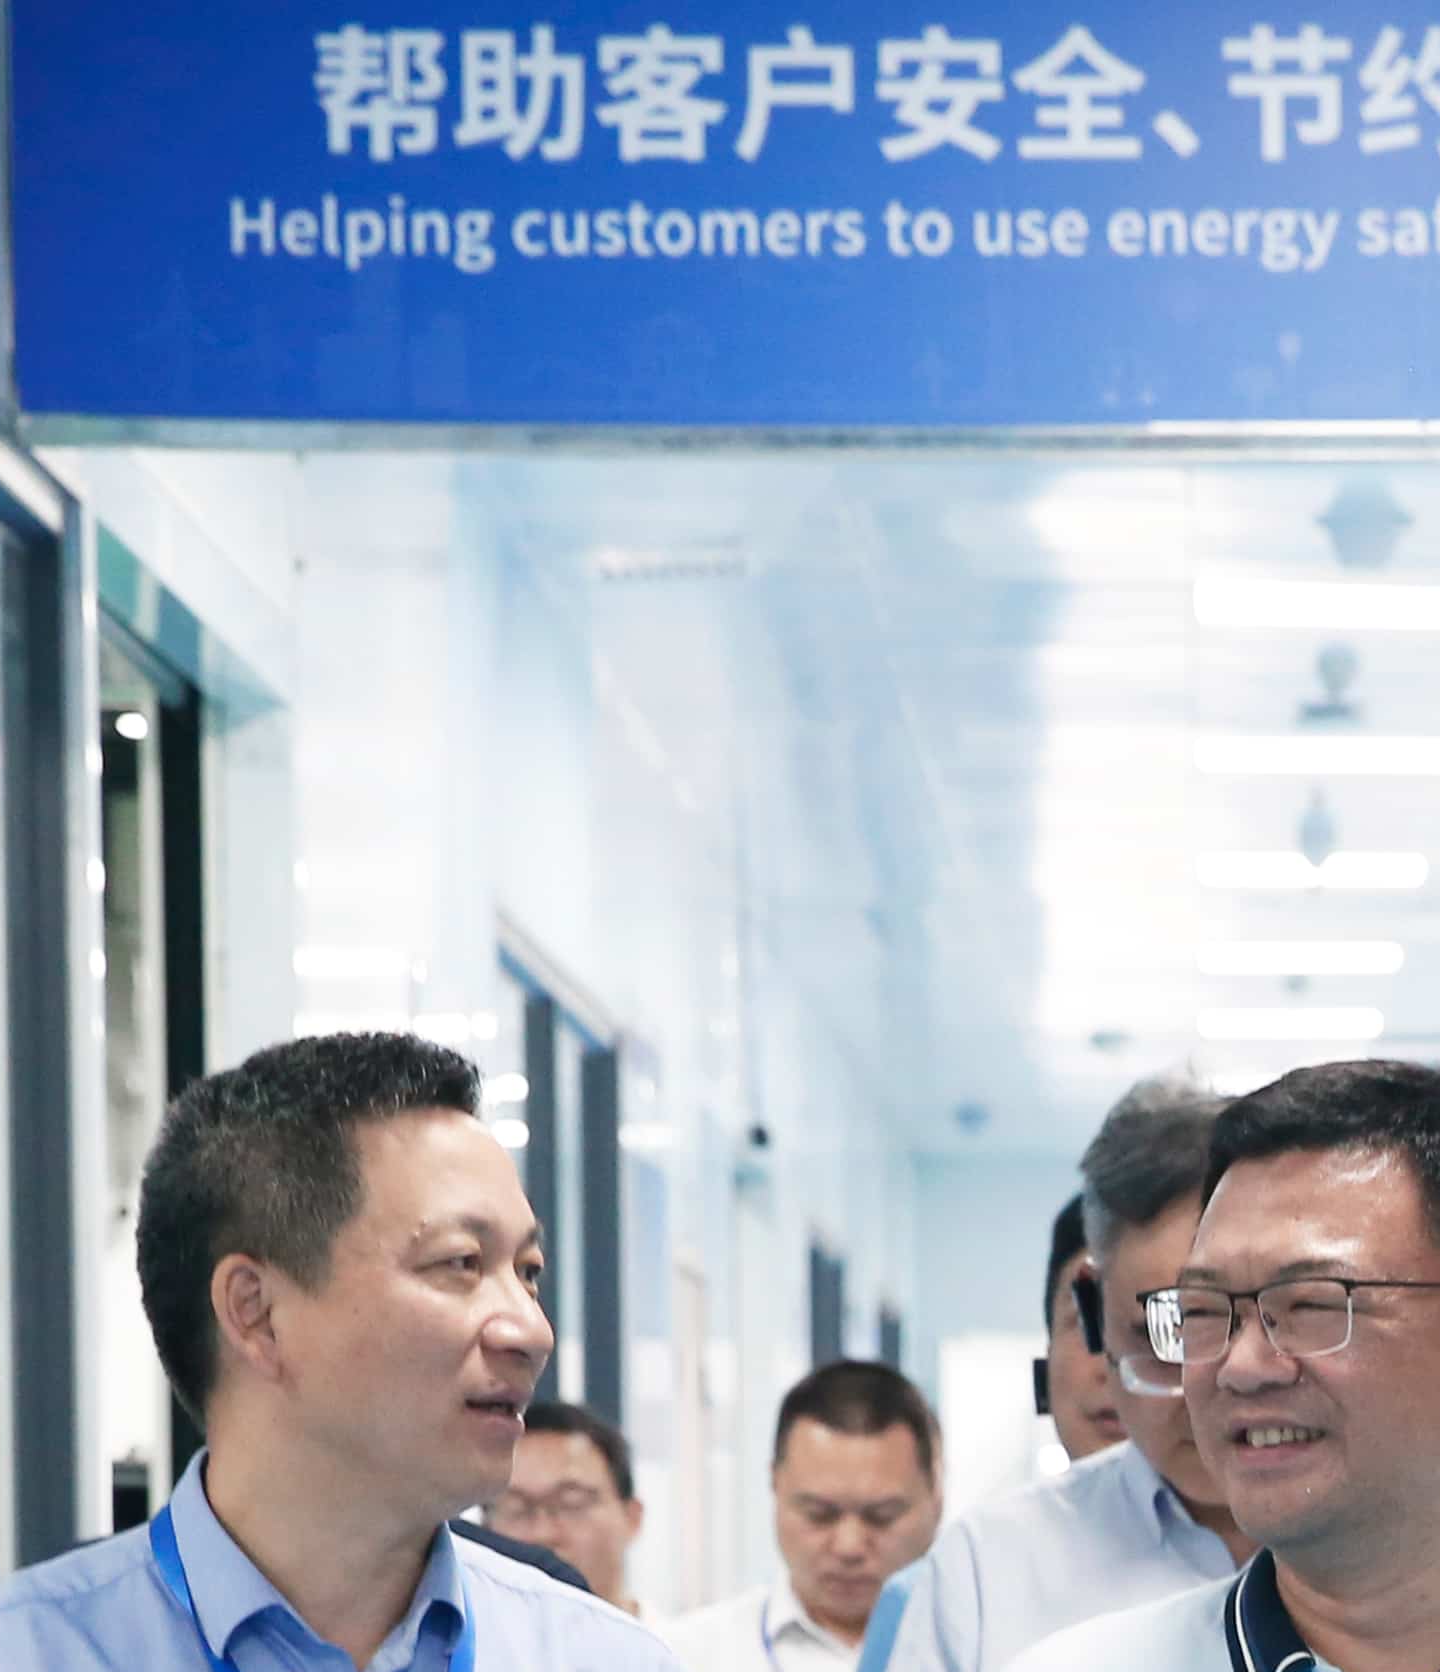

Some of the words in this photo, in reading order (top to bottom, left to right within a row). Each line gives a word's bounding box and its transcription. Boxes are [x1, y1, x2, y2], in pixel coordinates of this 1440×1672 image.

[230, 193, 495, 273] Helping
[512, 199, 866, 259] customers
[883, 199, 953, 258] to
[973, 208, 1088, 258] use
[1107, 208, 1338, 272] energy
